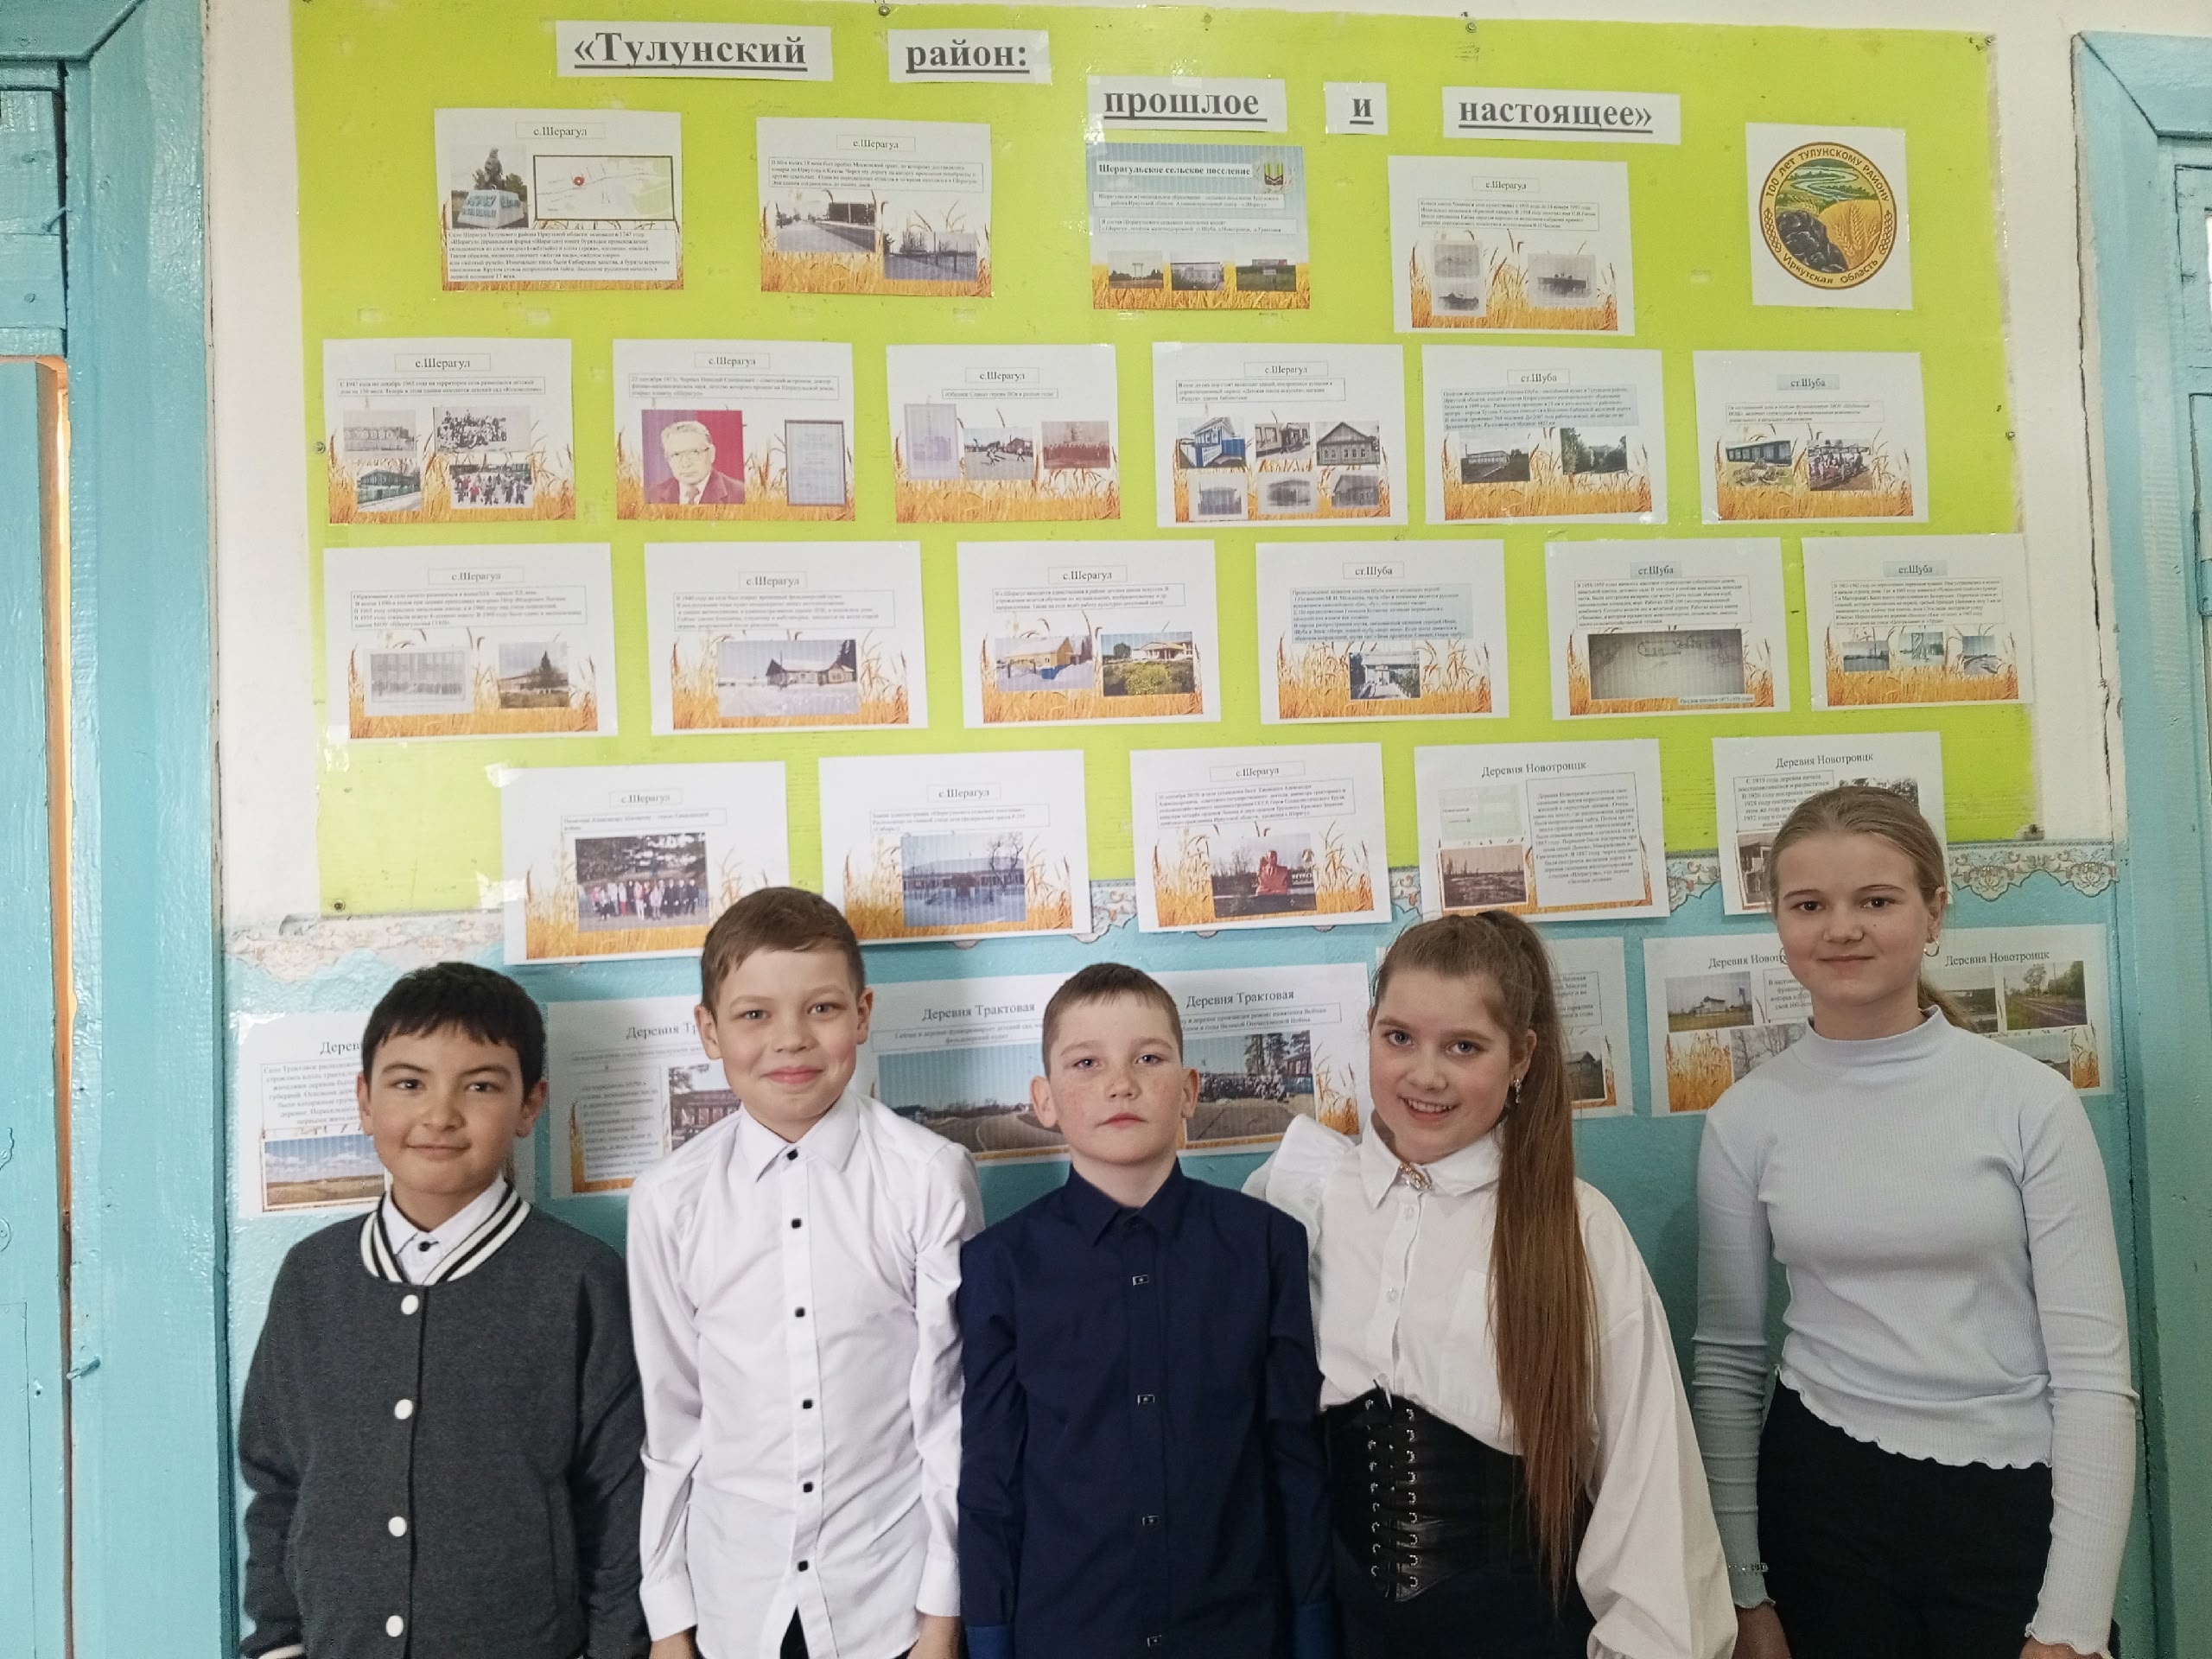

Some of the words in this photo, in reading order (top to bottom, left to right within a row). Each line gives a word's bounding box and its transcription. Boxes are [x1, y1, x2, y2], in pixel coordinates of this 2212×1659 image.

[574, 31, 807, 70] «Тулунский
[905, 37, 1029, 73] район:
[1103, 90, 1260, 120] прошлое
[1351, 97, 1373, 119] и
[1458, 98, 1654, 129] настоящее»
[533, 126, 588, 137] с.Шерагул
[853, 139, 899, 149] с.Шерагул
[1099, 163, 1164, 175] Шерагульское
[1165, 165, 1204, 175] сельское
[1206, 167, 1251, 176] поселение
[1764, 178, 1779, 198] 100
[1780, 158, 1796, 176] лет
[1798, 149, 1862, 166] ТУЛУНСКОМУ
[1485, 181, 1527, 190] с.Шерагул
[1783, 253, 1834, 284] Иркутская
[1840, 259, 1878, 284] Область
[416, 358, 471, 370] с.Шерагул
[709, 356, 756, 367] с.Шерагул
[1265, 365, 1308, 375] с.Шерагул
[980, 371, 1026, 382] с.Шерагул
[1521, 374, 1558, 385] ст.Шуба
[1790, 378, 1827, 389] ст.Шуба
[1355, 566, 1393, 577] ст.Шуба
[1637, 566, 1675, 577] ст.Шуба
[1898, 564, 1934, 575] ст.Шуба
[452, 571, 502, 582] с.Шерагул
[747, 576, 800, 588] с.Шерагул
[1063, 570, 1112, 582] с.Шерагул
[1776, 758, 1815, 769] Деревня
[1818, 753, 1873, 765] Новотроицк
[1235, 767, 1280, 778] с.Шерагул
[1481, 766, 1522, 777] Деревня
[1526, 761, 1586, 774] Новотроицк
[621, 794, 671, 805] с.Шерагул
[938, 788, 990, 799] с.Шерагул
[1708, 957, 1749, 969] Деревня
[1945, 956, 1986, 967] Деревня
[1990, 951, 2050, 962] Новотроицк
[1186, 995, 1234, 1008] Деревня
[1237, 990, 1294, 1004] Трактовая
[922, 1008, 972, 1021] Деревня
[975, 1002, 1036, 1018] Трактовая
[626, 1027, 679, 1039] Деревня
[320, 1040, 361, 1055] Дерев
